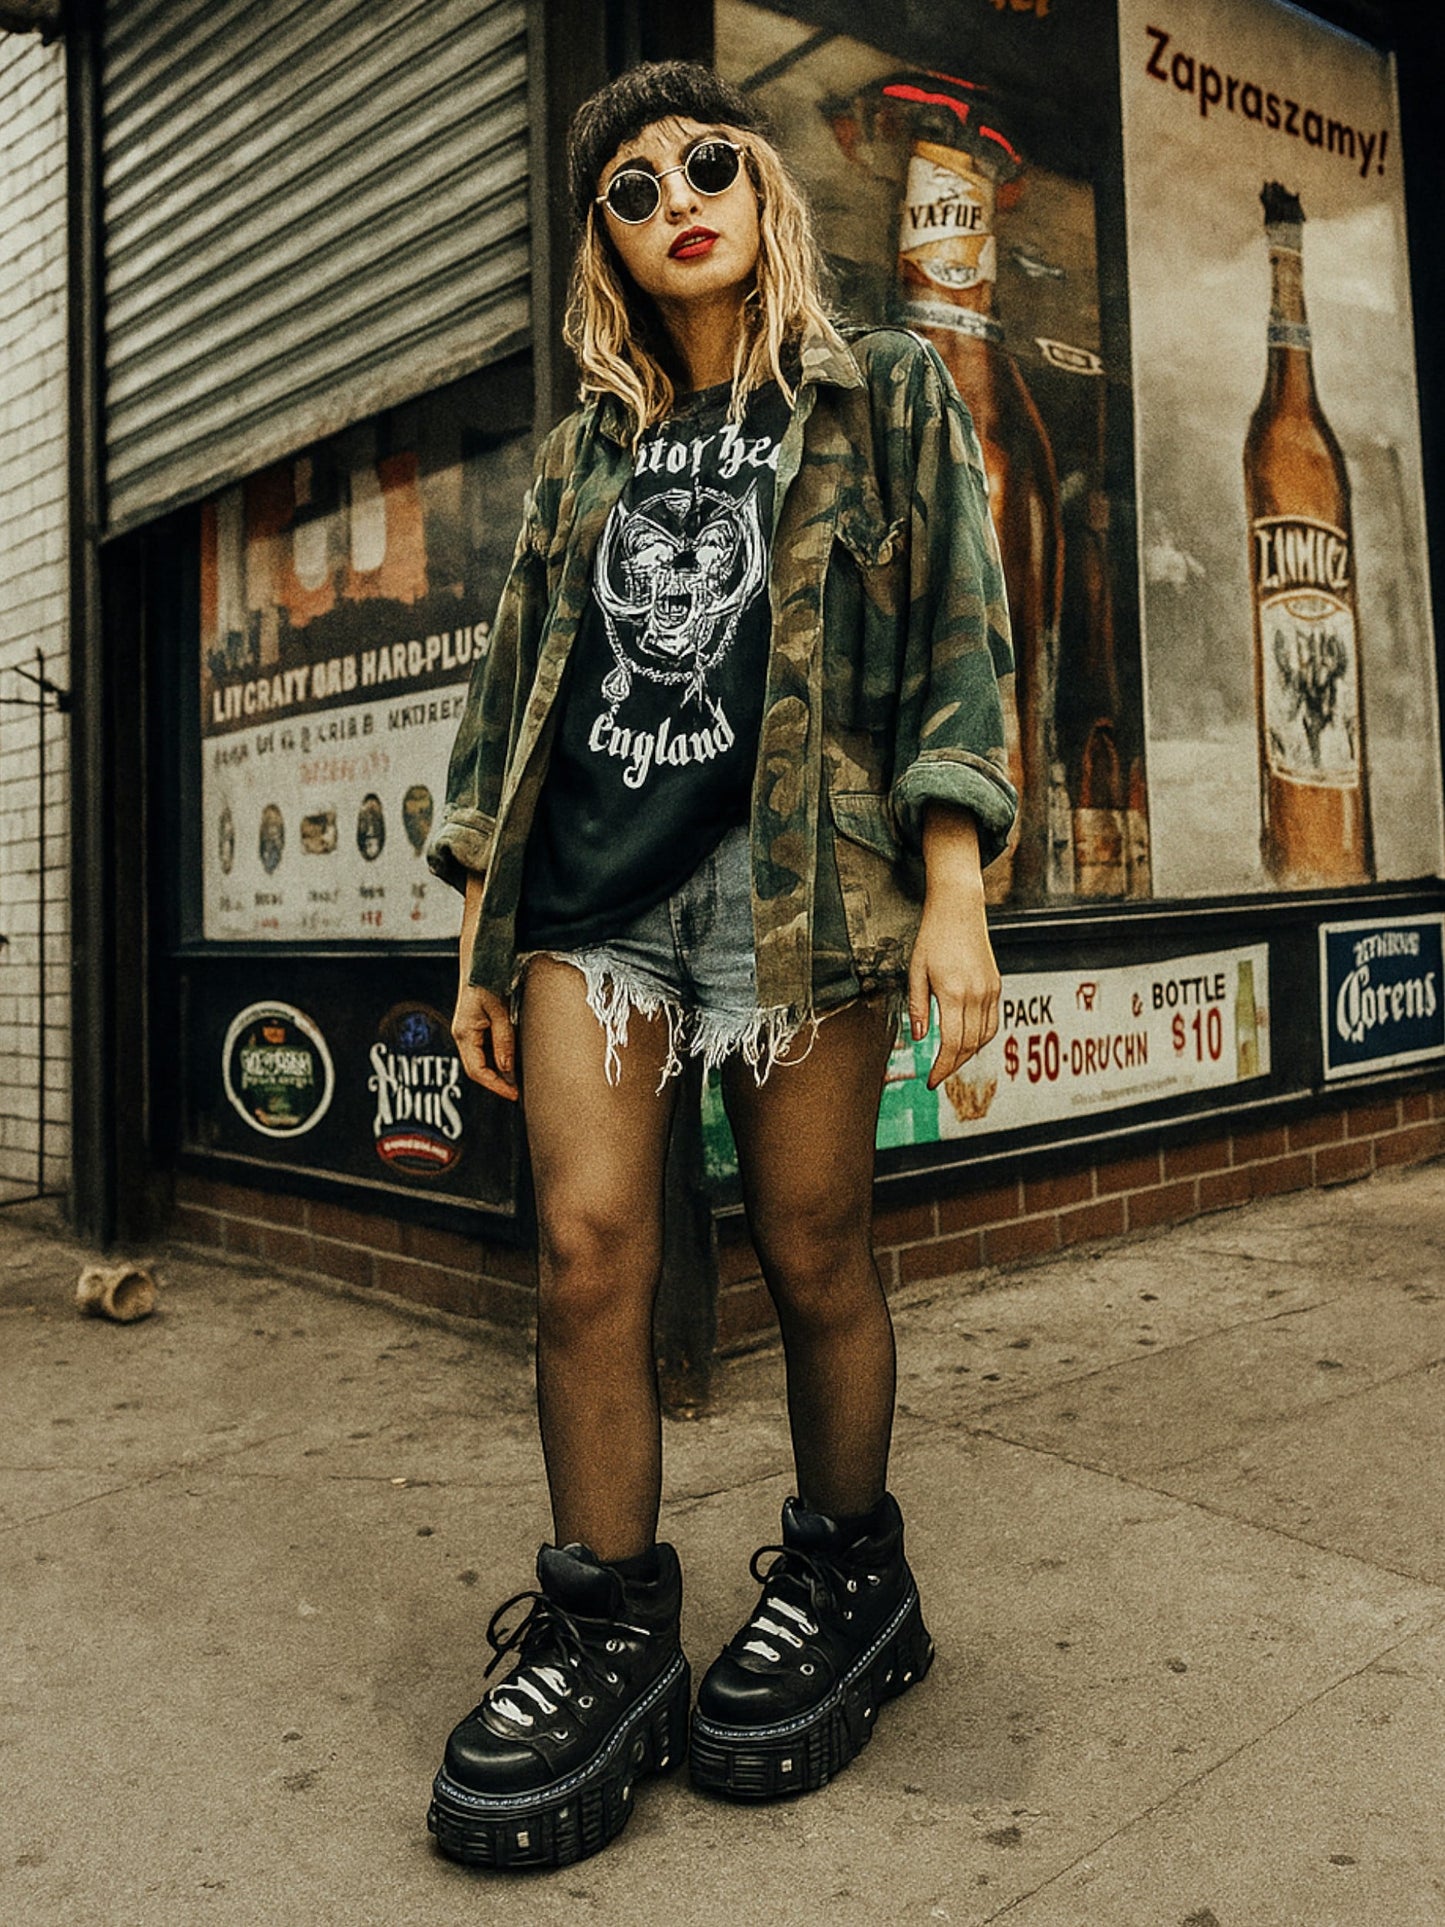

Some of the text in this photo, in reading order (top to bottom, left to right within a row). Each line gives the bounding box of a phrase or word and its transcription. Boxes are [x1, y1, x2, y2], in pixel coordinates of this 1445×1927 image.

[1145, 25, 1388, 179] Zapraszamy!
[1003, 995, 1054, 1030] PACK
[1152, 973, 1226, 1010] BOTTLE
[1171, 1006, 1222, 1063] $10
